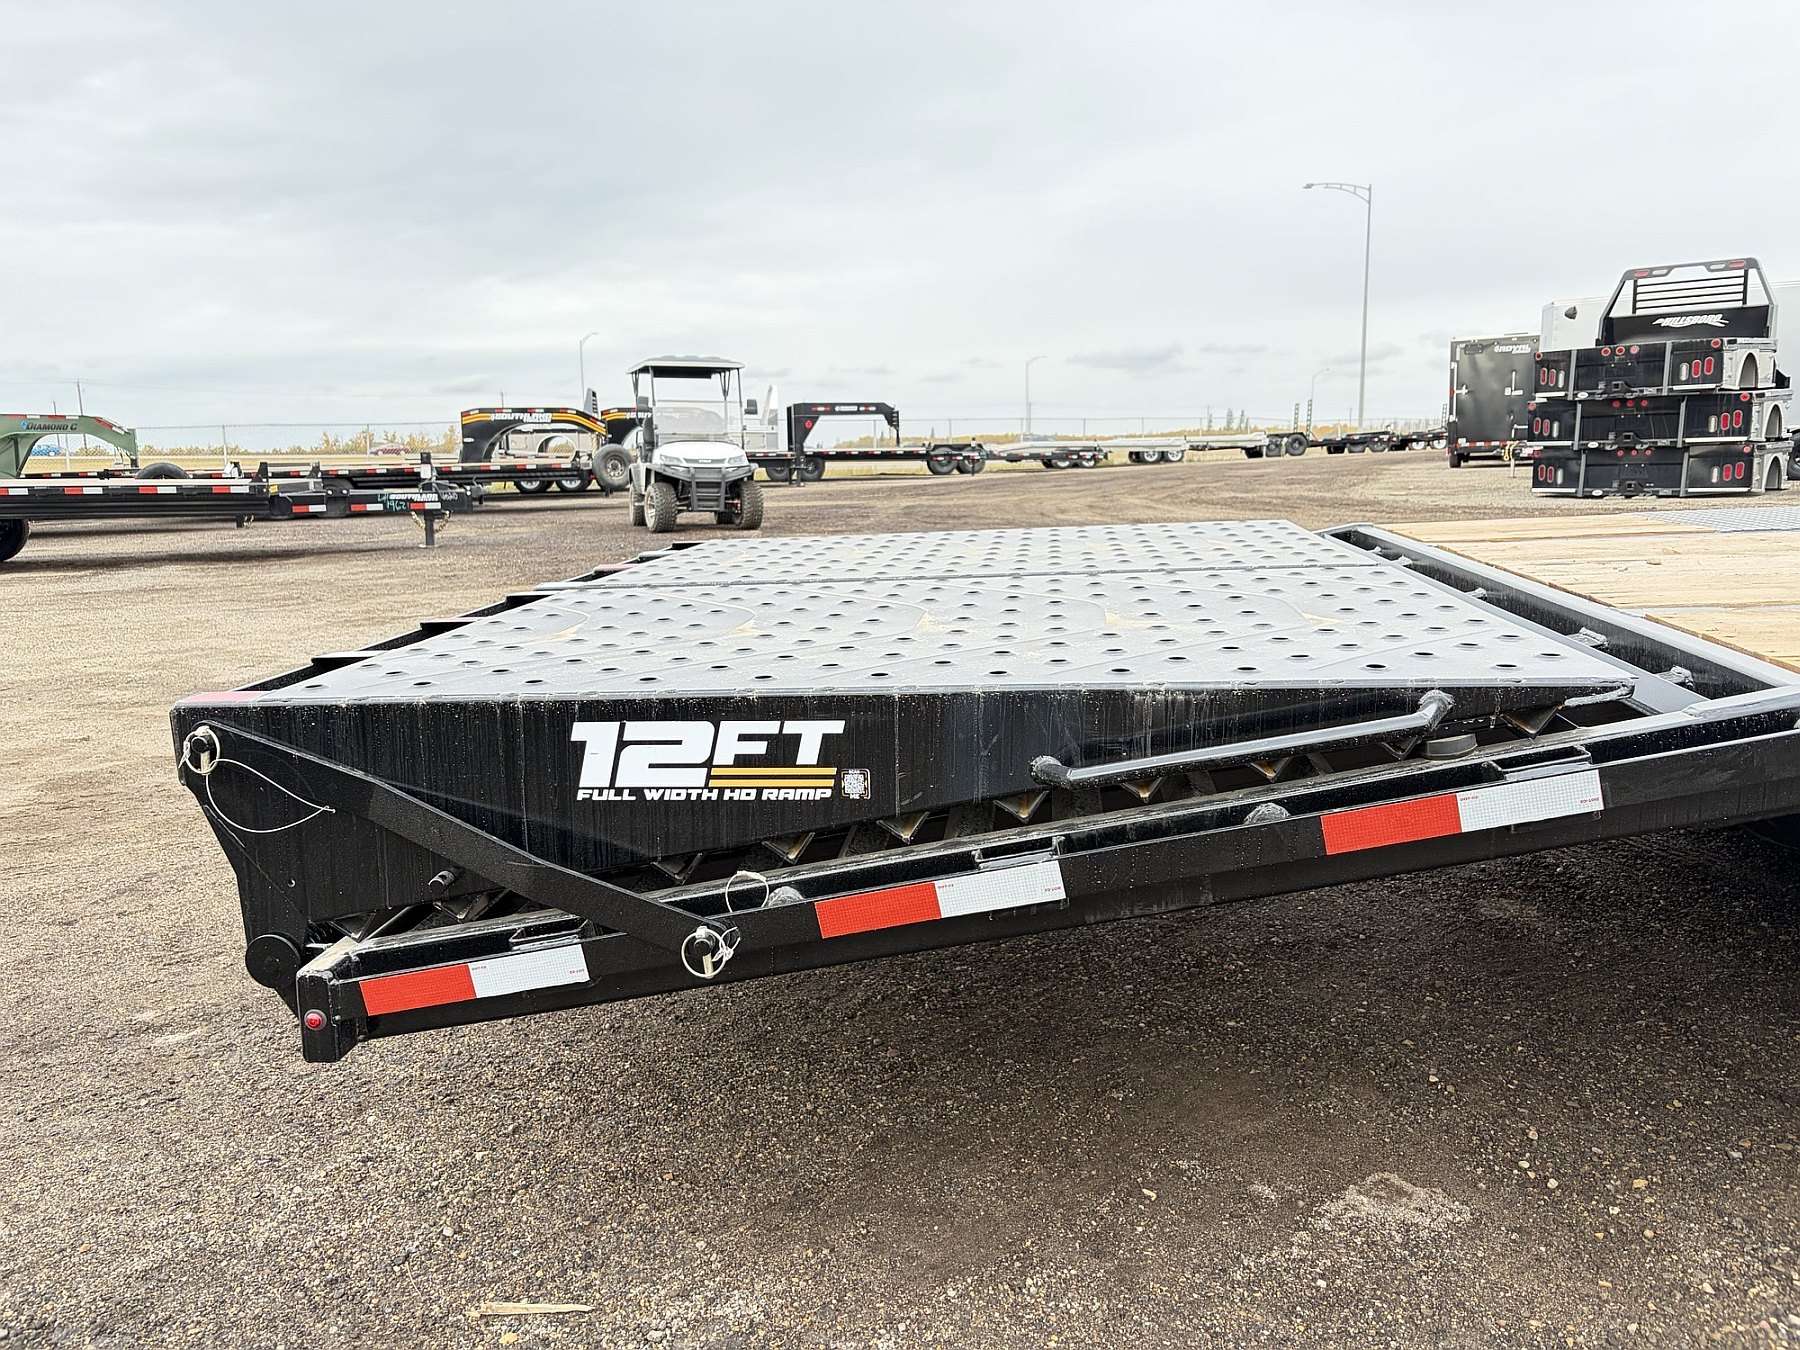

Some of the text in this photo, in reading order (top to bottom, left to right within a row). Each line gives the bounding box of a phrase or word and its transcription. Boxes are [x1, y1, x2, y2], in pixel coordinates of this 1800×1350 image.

[570, 720, 846, 788] 12FT
[577, 788, 832, 801] FULL WIDTH HD RAMP
